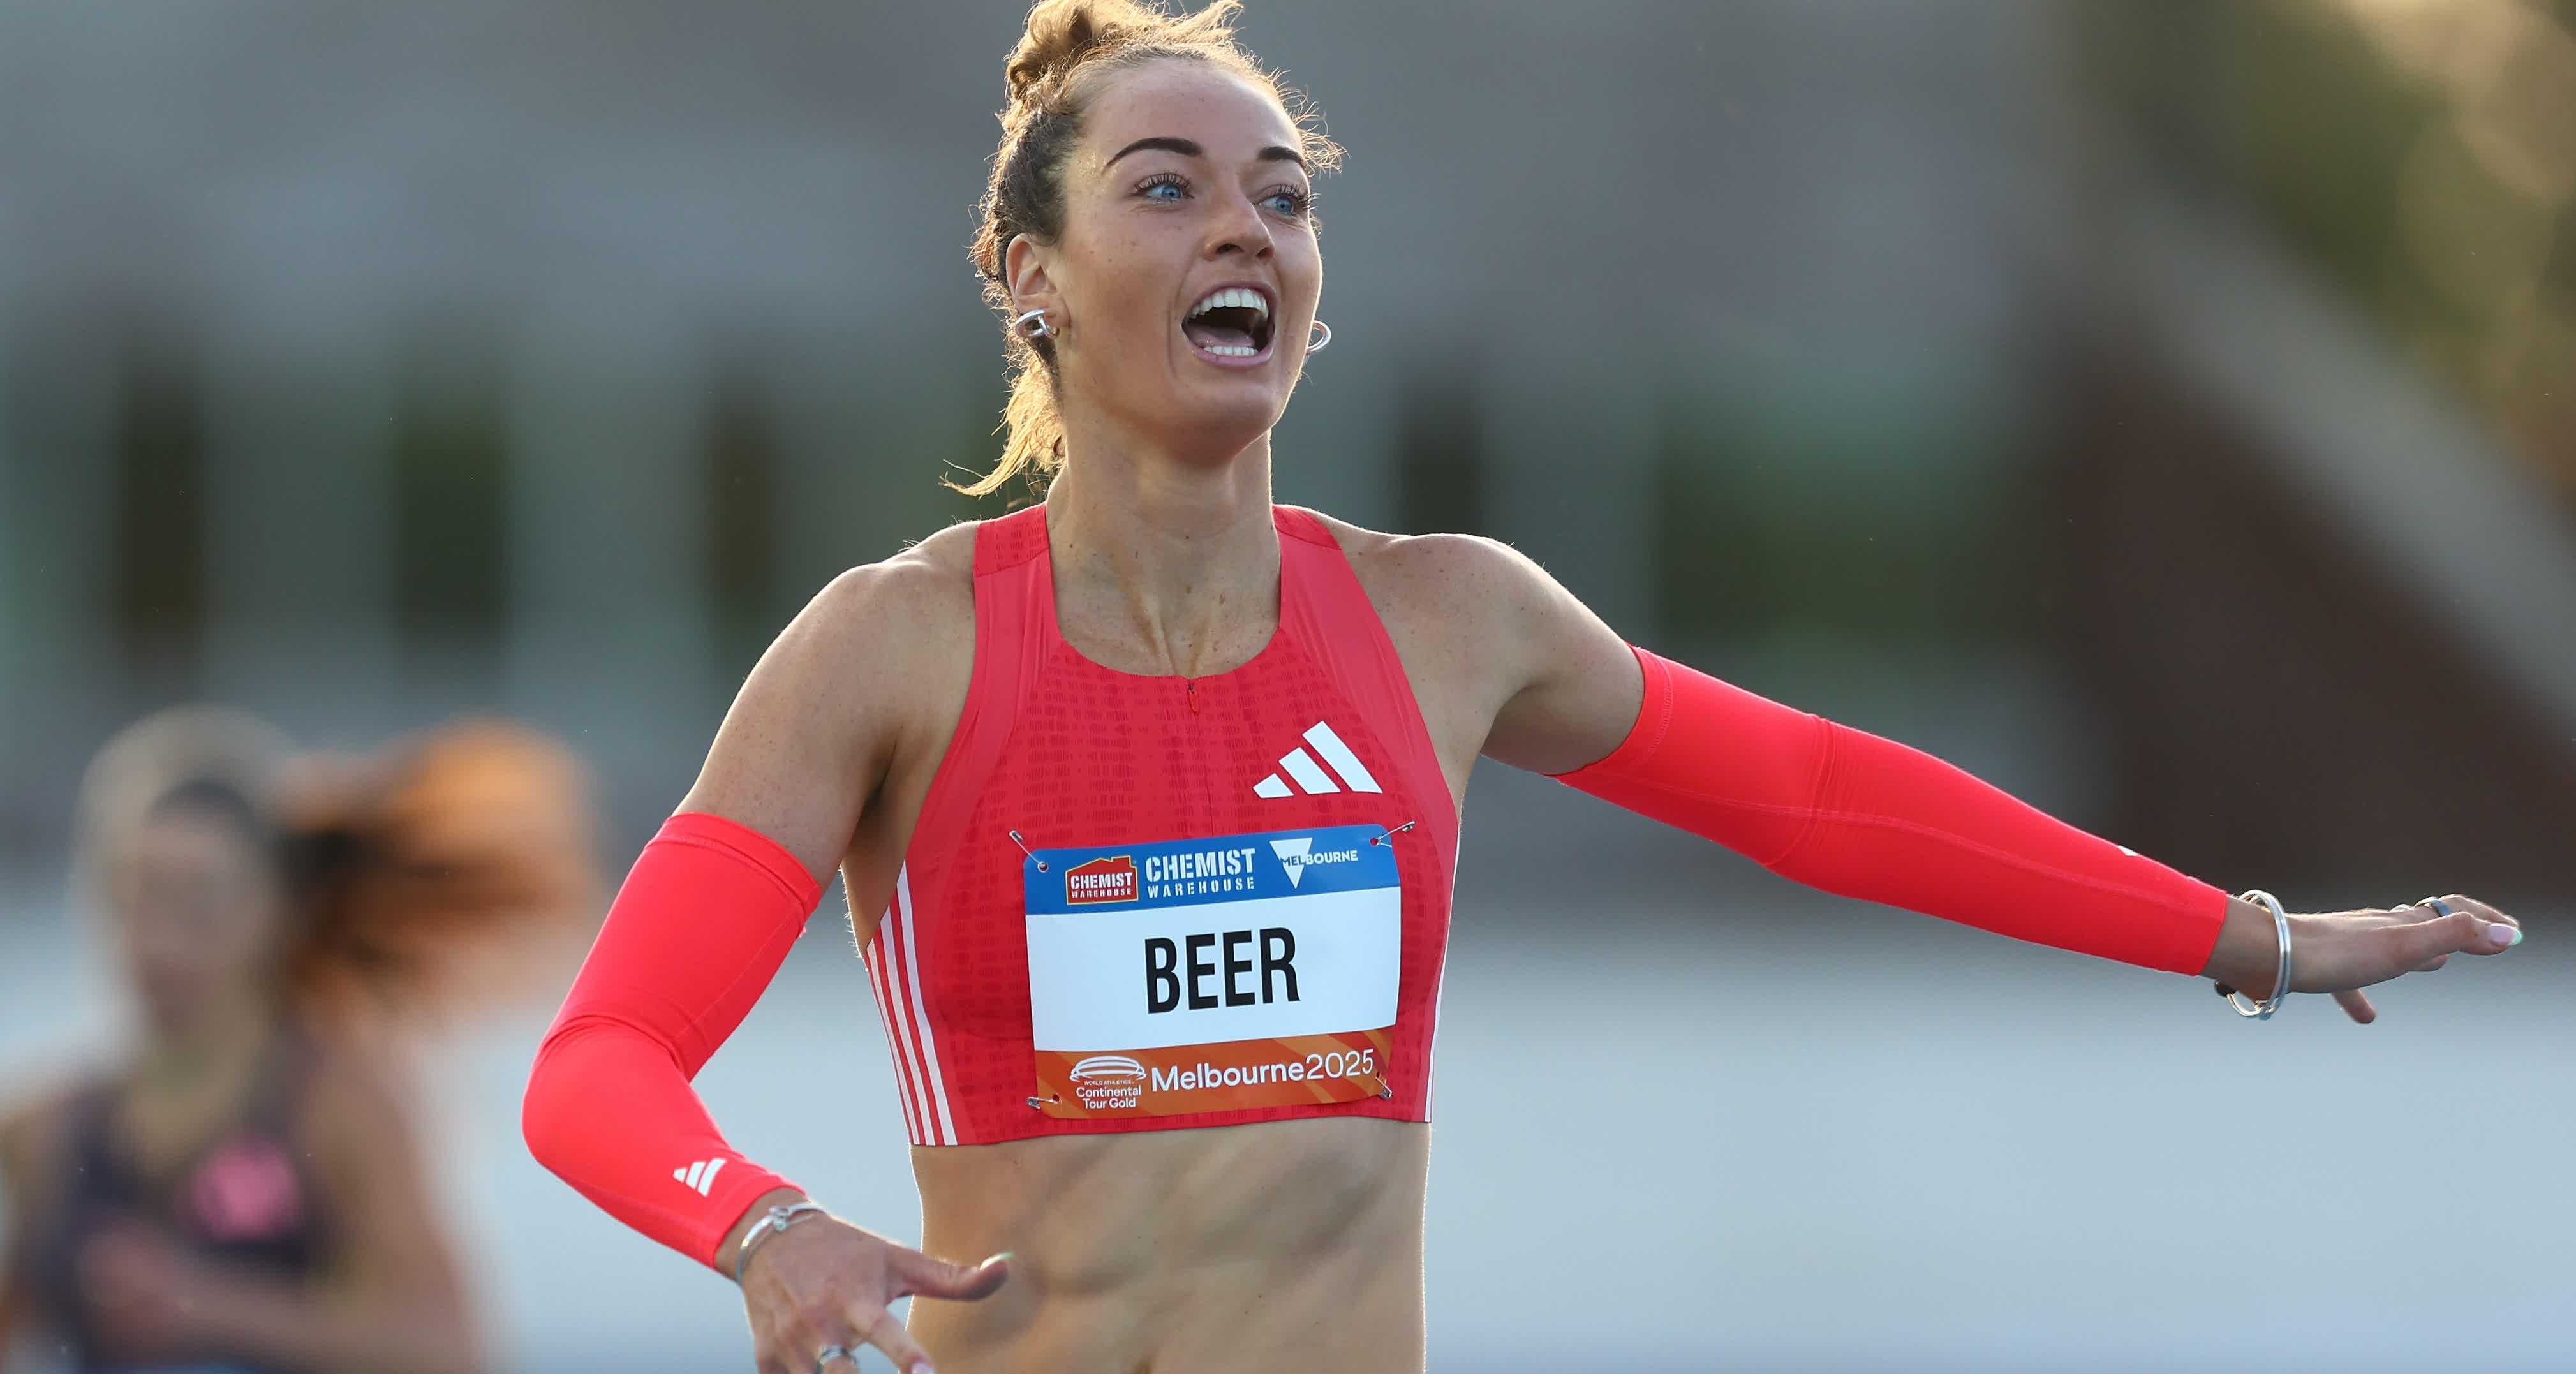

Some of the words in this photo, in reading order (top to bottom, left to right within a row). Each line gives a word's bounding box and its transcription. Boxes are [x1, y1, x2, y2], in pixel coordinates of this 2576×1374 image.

[1146, 848, 1255, 883] CHEMIST
[1280, 850, 1358, 866] MELBOURNE
[1070, 872, 1133, 889] CHEMIST
[1147, 876, 1255, 899] WAREHOUSE
[1071, 887, 1132, 899] WAREHOUSE
[1144, 927, 1301, 1014] BEER
[1151, 1048, 1374, 1092] Melbourne2025
[1076, 1084, 1141, 1098] Continental
[1082, 1098, 1107, 1109] Tour
[1109, 1097, 1136, 1109] Gold
